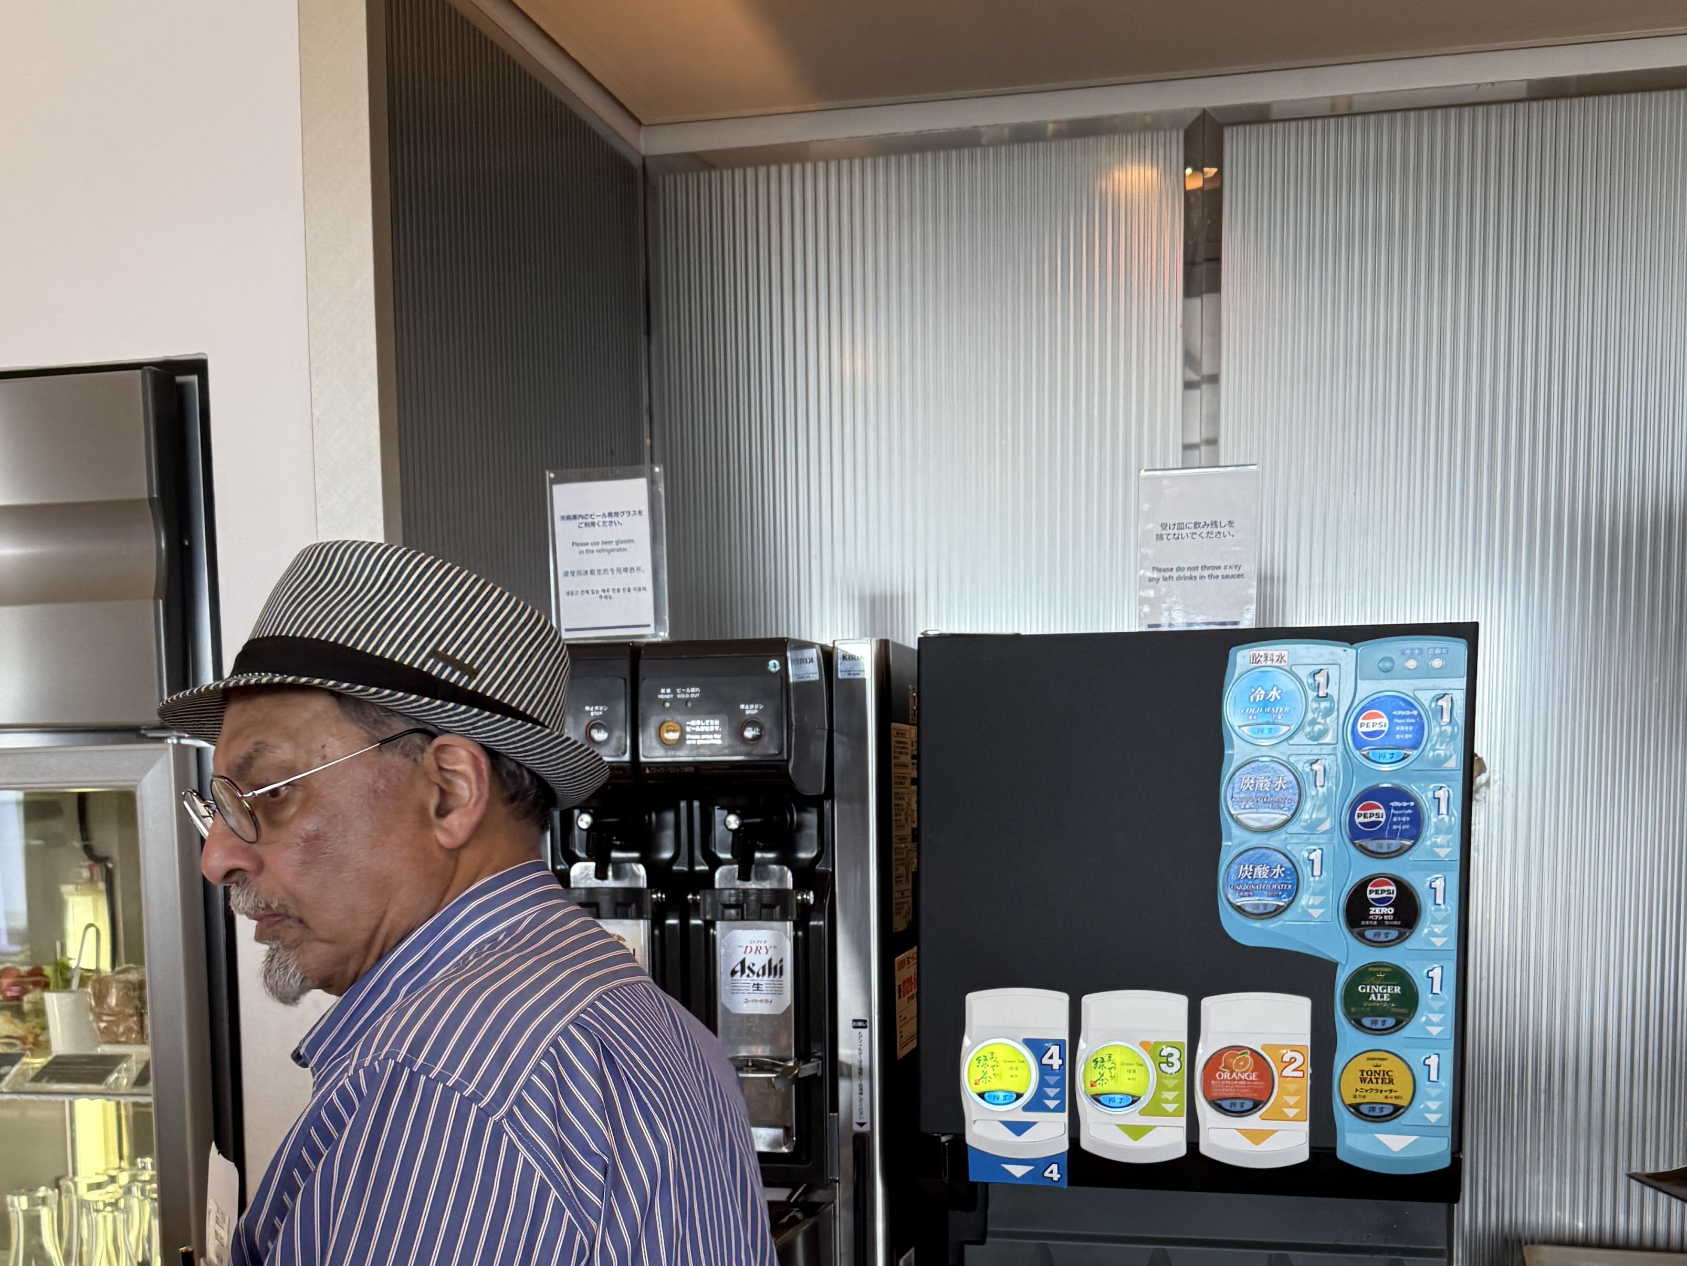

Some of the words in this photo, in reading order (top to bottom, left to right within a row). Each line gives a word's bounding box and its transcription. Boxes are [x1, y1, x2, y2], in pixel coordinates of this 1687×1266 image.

[1160, 520, 1235, 531] 受け皿に飲み残しを
[1155, 530, 1235, 542] 捨てないでください。
[1152, 565, 1174, 573] Please
[1187, 564, 1199, 572] not
[1148, 576, 1160, 584] any
[1162, 574, 1174, 582] left
[1175, 573, 1198, 581] drinks
[1250, 652, 1287, 665] 飲料水
[1313, 668, 1329, 698] 1
[1249, 686, 1282, 702] 冷水
[1264, 706, 1290, 714] WATER
[1437, 693, 1453, 725] 1
[1359, 721, 1387, 729] PEPSI
[1310, 758, 1327, 788] 1
[1240, 776, 1288, 792] 炭酸水
[1433, 786, 1449, 816] 1
[1356, 812, 1384, 820] PEPSI
[1308, 848, 1324, 878] 1
[1238, 864, 1286, 880] 炭酸水
[1368, 888, 1395, 896] PEPSI
[1430, 876, 1446, 906] 1
[730, 957, 784, 979] Asahi
[752, 982, 764, 991] 生
[1427, 965, 1443, 995] 1
[1358, 984, 1401, 994] GINGER
[1369, 993, 1390, 1002] ALE
[1041, 1044, 1063, 1071] 4
[1159, 1046, 1182, 1075] 3
[1281, 1050, 1305, 1078] 2
[1359, 1069, 1393, 1077] TONIC
[1423, 1053, 1439, 1082] 1
[1215, 1071, 1258, 1081] ORANGE
[1359, 1077, 1394, 1085] WATER
[1043, 1162, 1061, 1181] 4
